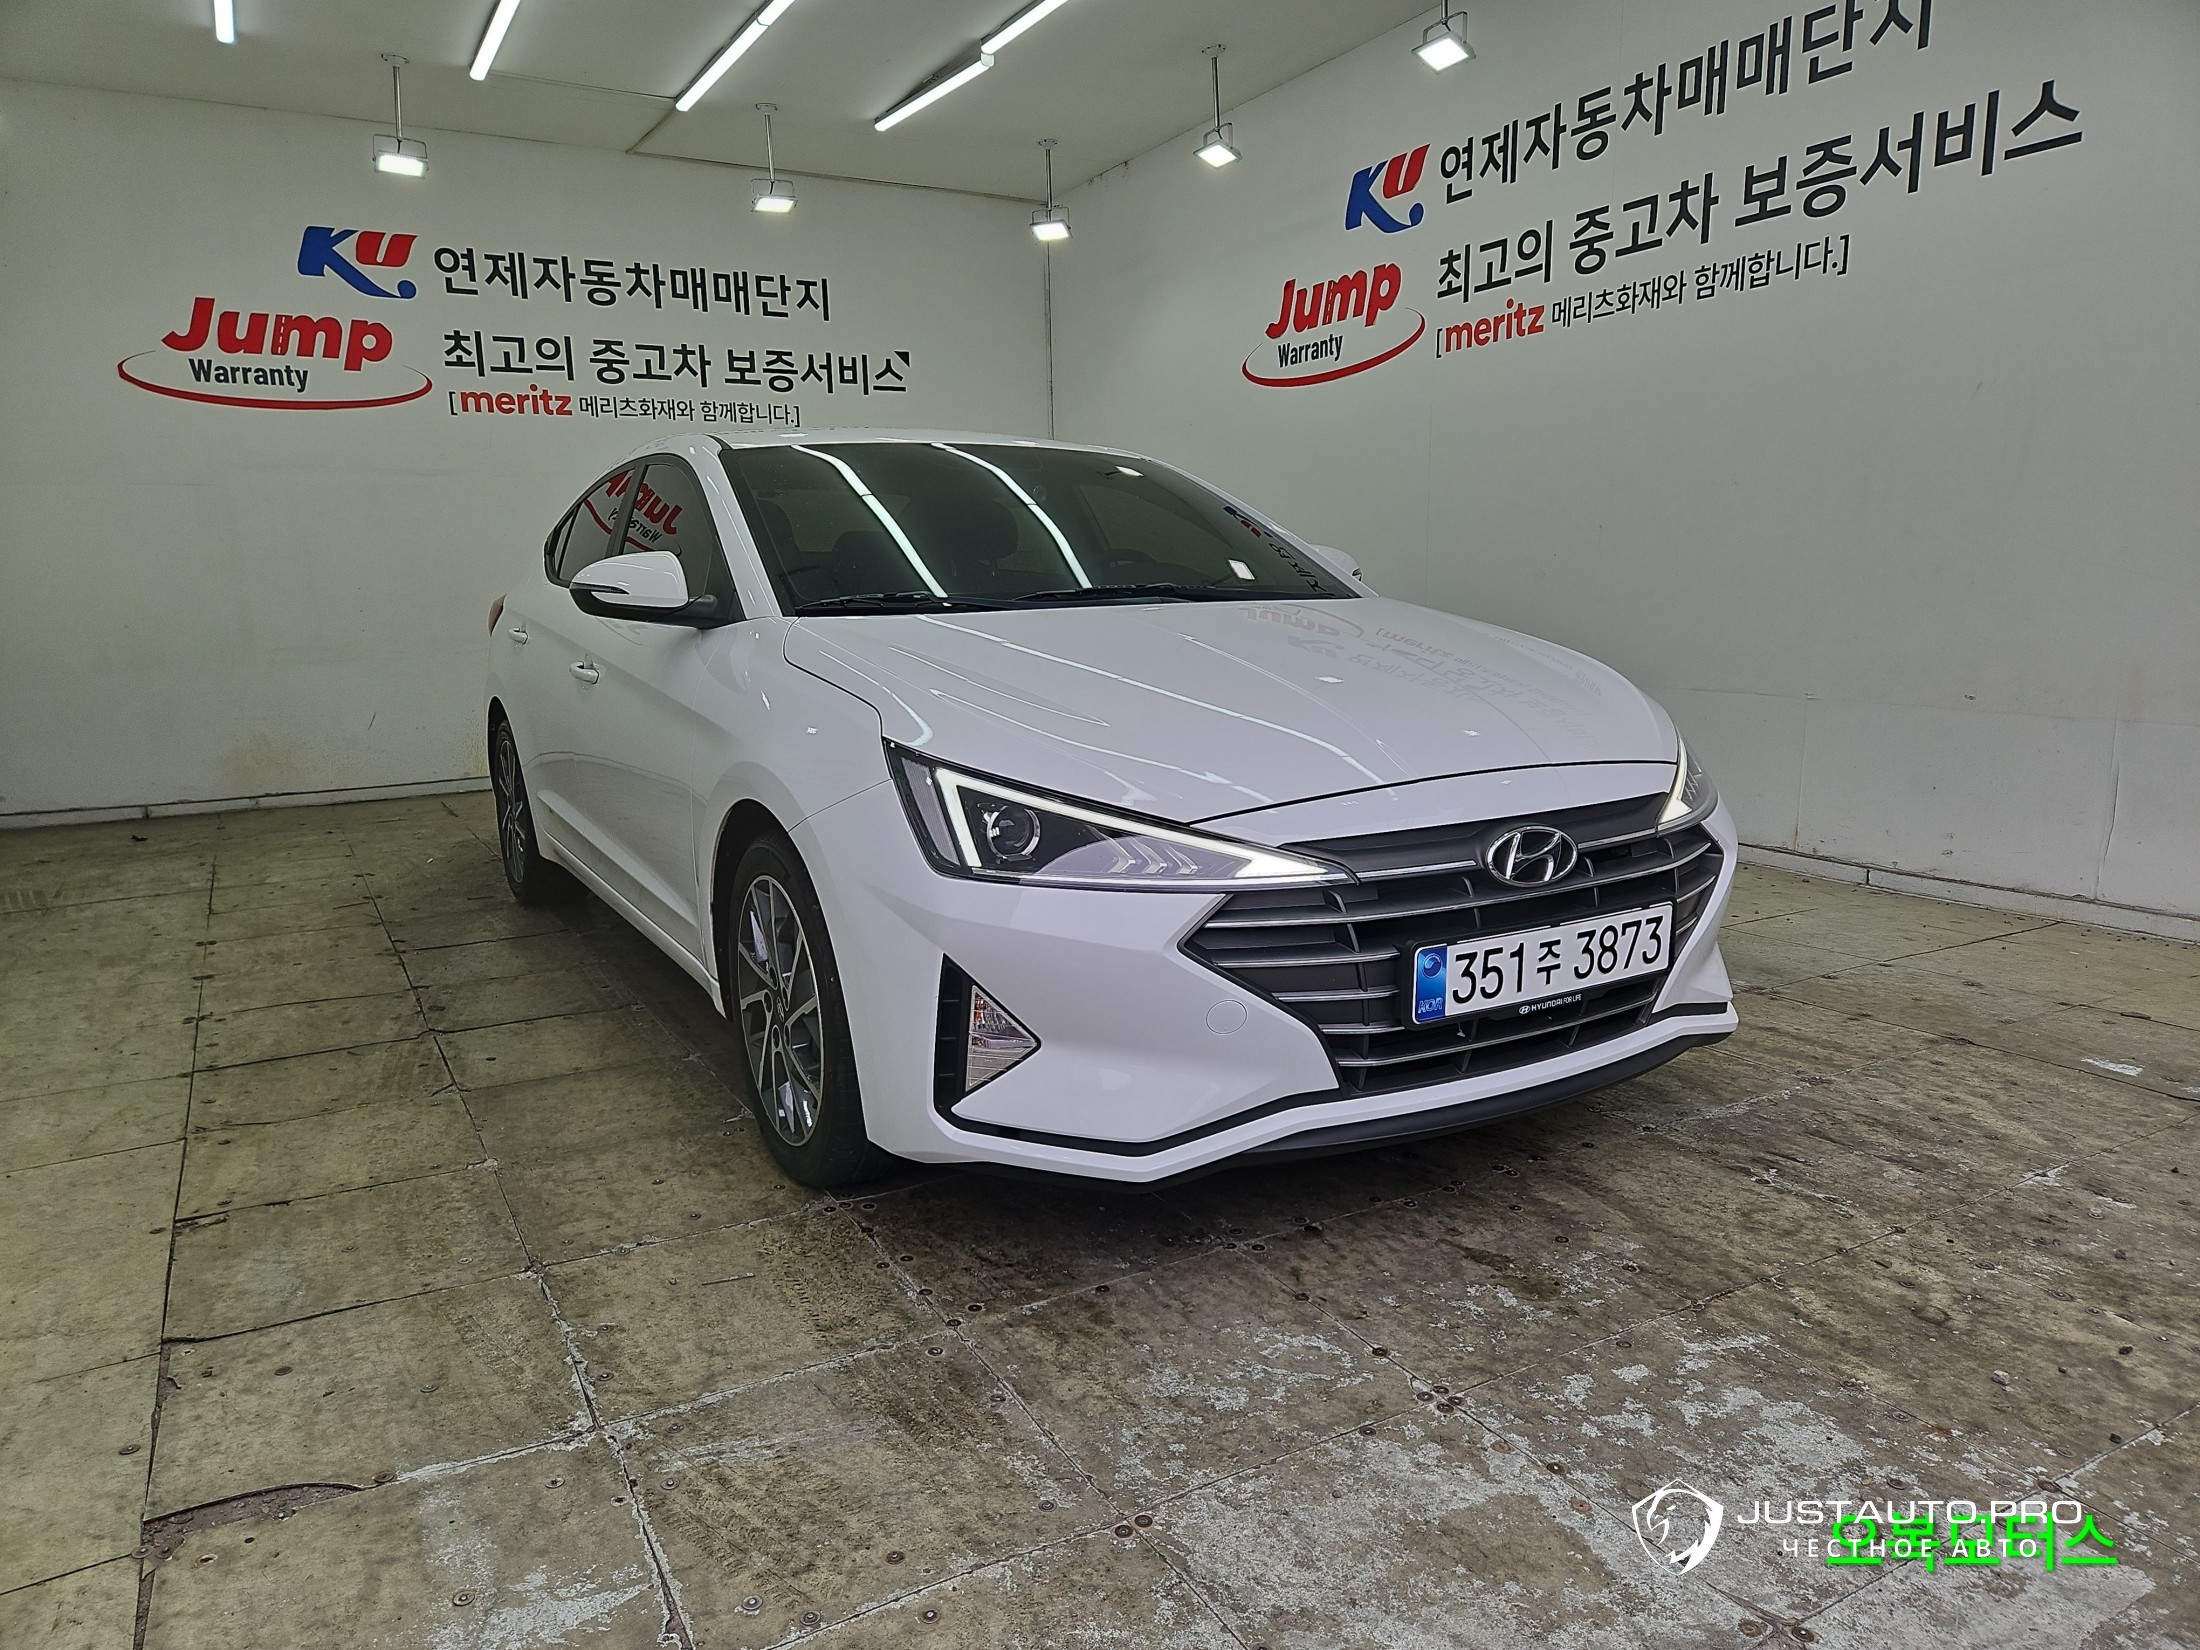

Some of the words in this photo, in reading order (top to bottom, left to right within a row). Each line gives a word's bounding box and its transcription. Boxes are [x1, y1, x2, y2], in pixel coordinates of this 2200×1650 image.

[1437, 219, 1553, 303] 최고의
[1569, 172, 1719, 275] 중고차
[1735, 79, 2083, 227] 보증서비스
[434, 247, 829, 321] 연제자동차매매단지
[1265, 263, 1402, 339] Jump
[1552, 270, 1687, 328] 메리츠화재와
[1695, 234, 1850, 300] 함께합니다.]
[161, 297, 393, 371] Jump
[444, 330, 574, 381] 최고의
[589, 338, 711, 388] 중고차
[725, 349, 907, 395] 보증서비스
[1278, 333, 1343, 368] Warranty
[188, 358, 308, 393] Warranty
[579, 395, 695, 422] 메리츠화재와
[700, 400, 800, 427] 함께합니다.]
[1452, 939, 1561, 1004] 351주
[1573, 915, 1664, 980] 3873
[1531, 999, 1563, 1011] HYUNDAI
